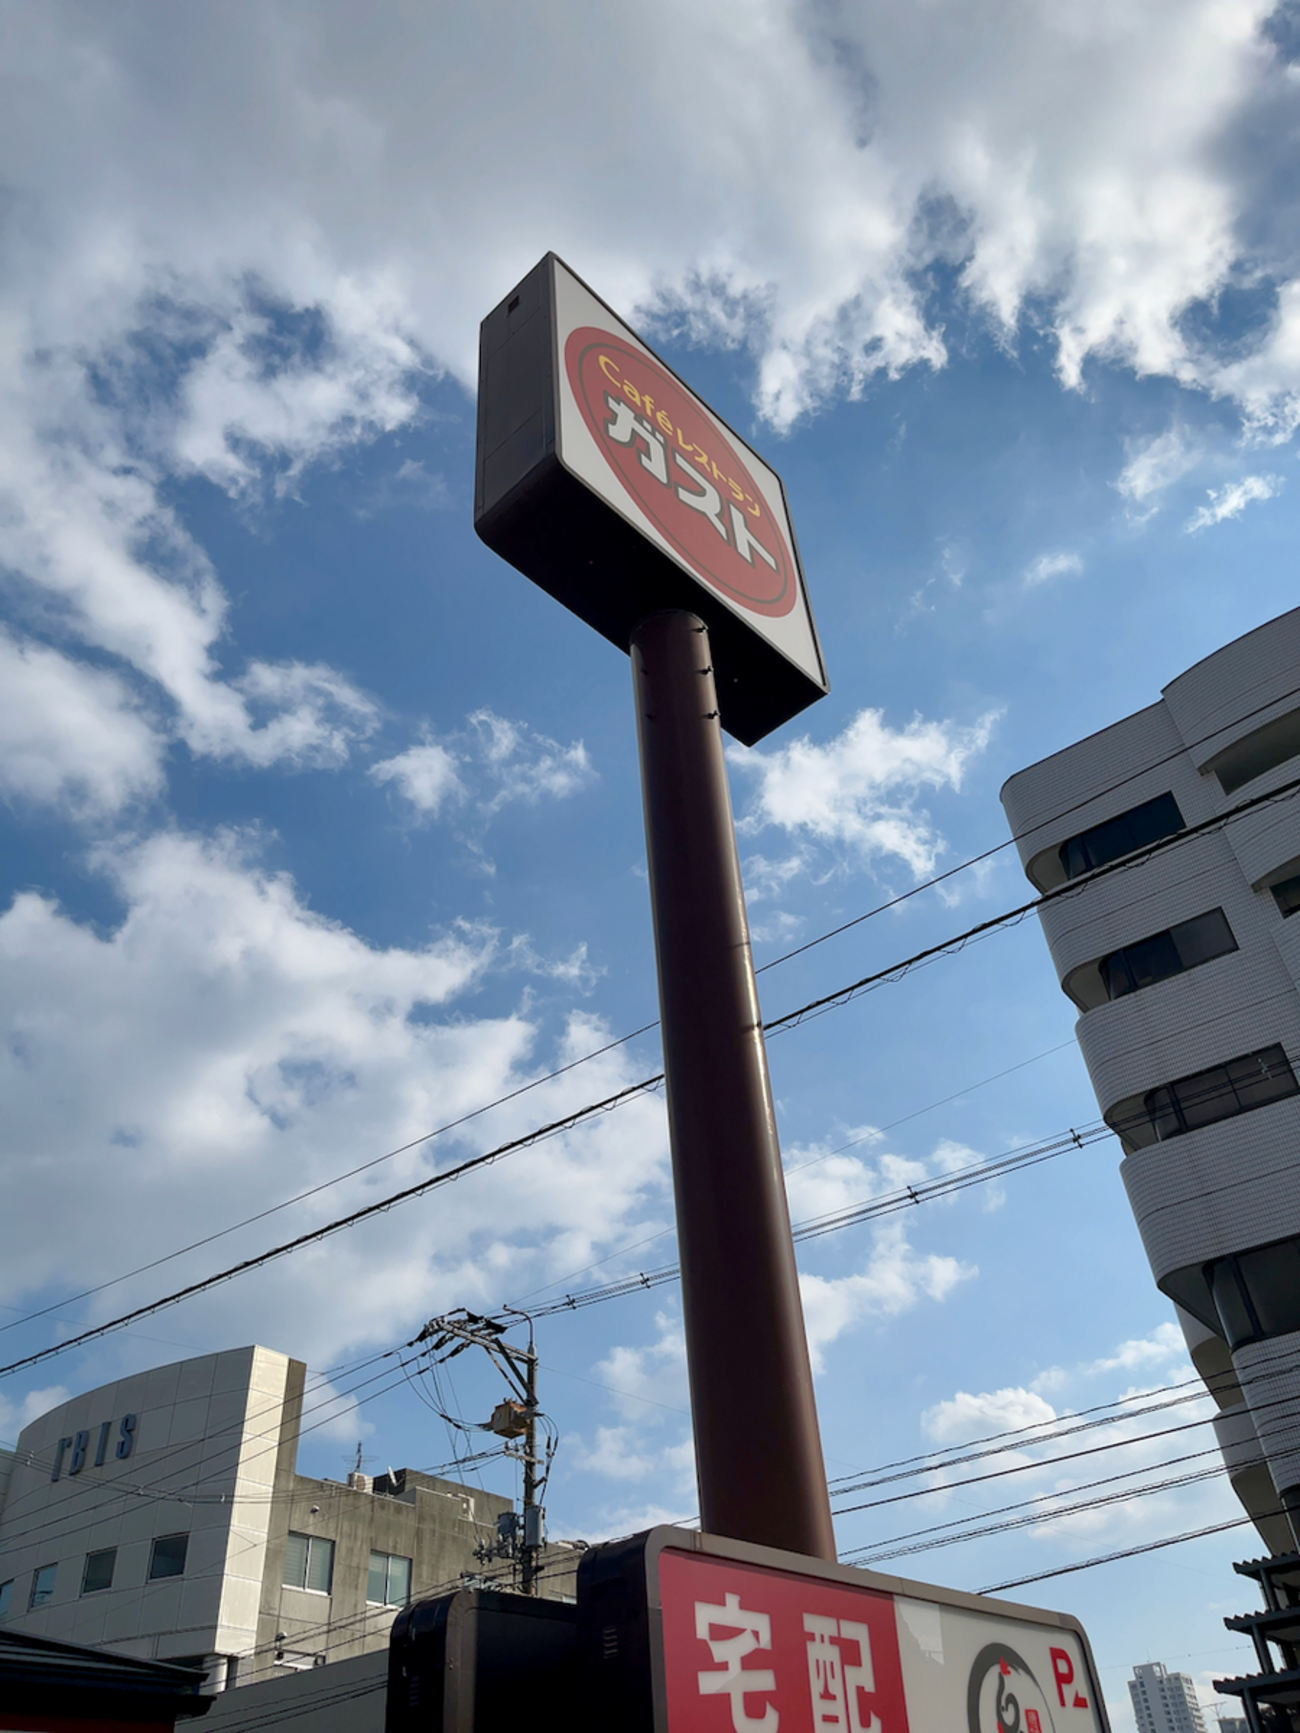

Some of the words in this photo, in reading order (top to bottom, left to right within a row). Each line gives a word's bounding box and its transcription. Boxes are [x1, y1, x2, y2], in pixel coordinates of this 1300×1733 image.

[606, 392, 780, 576] ガスト
[694, 1592, 882, 1733] 宅配
[1049, 1646, 1075, 1708] P
